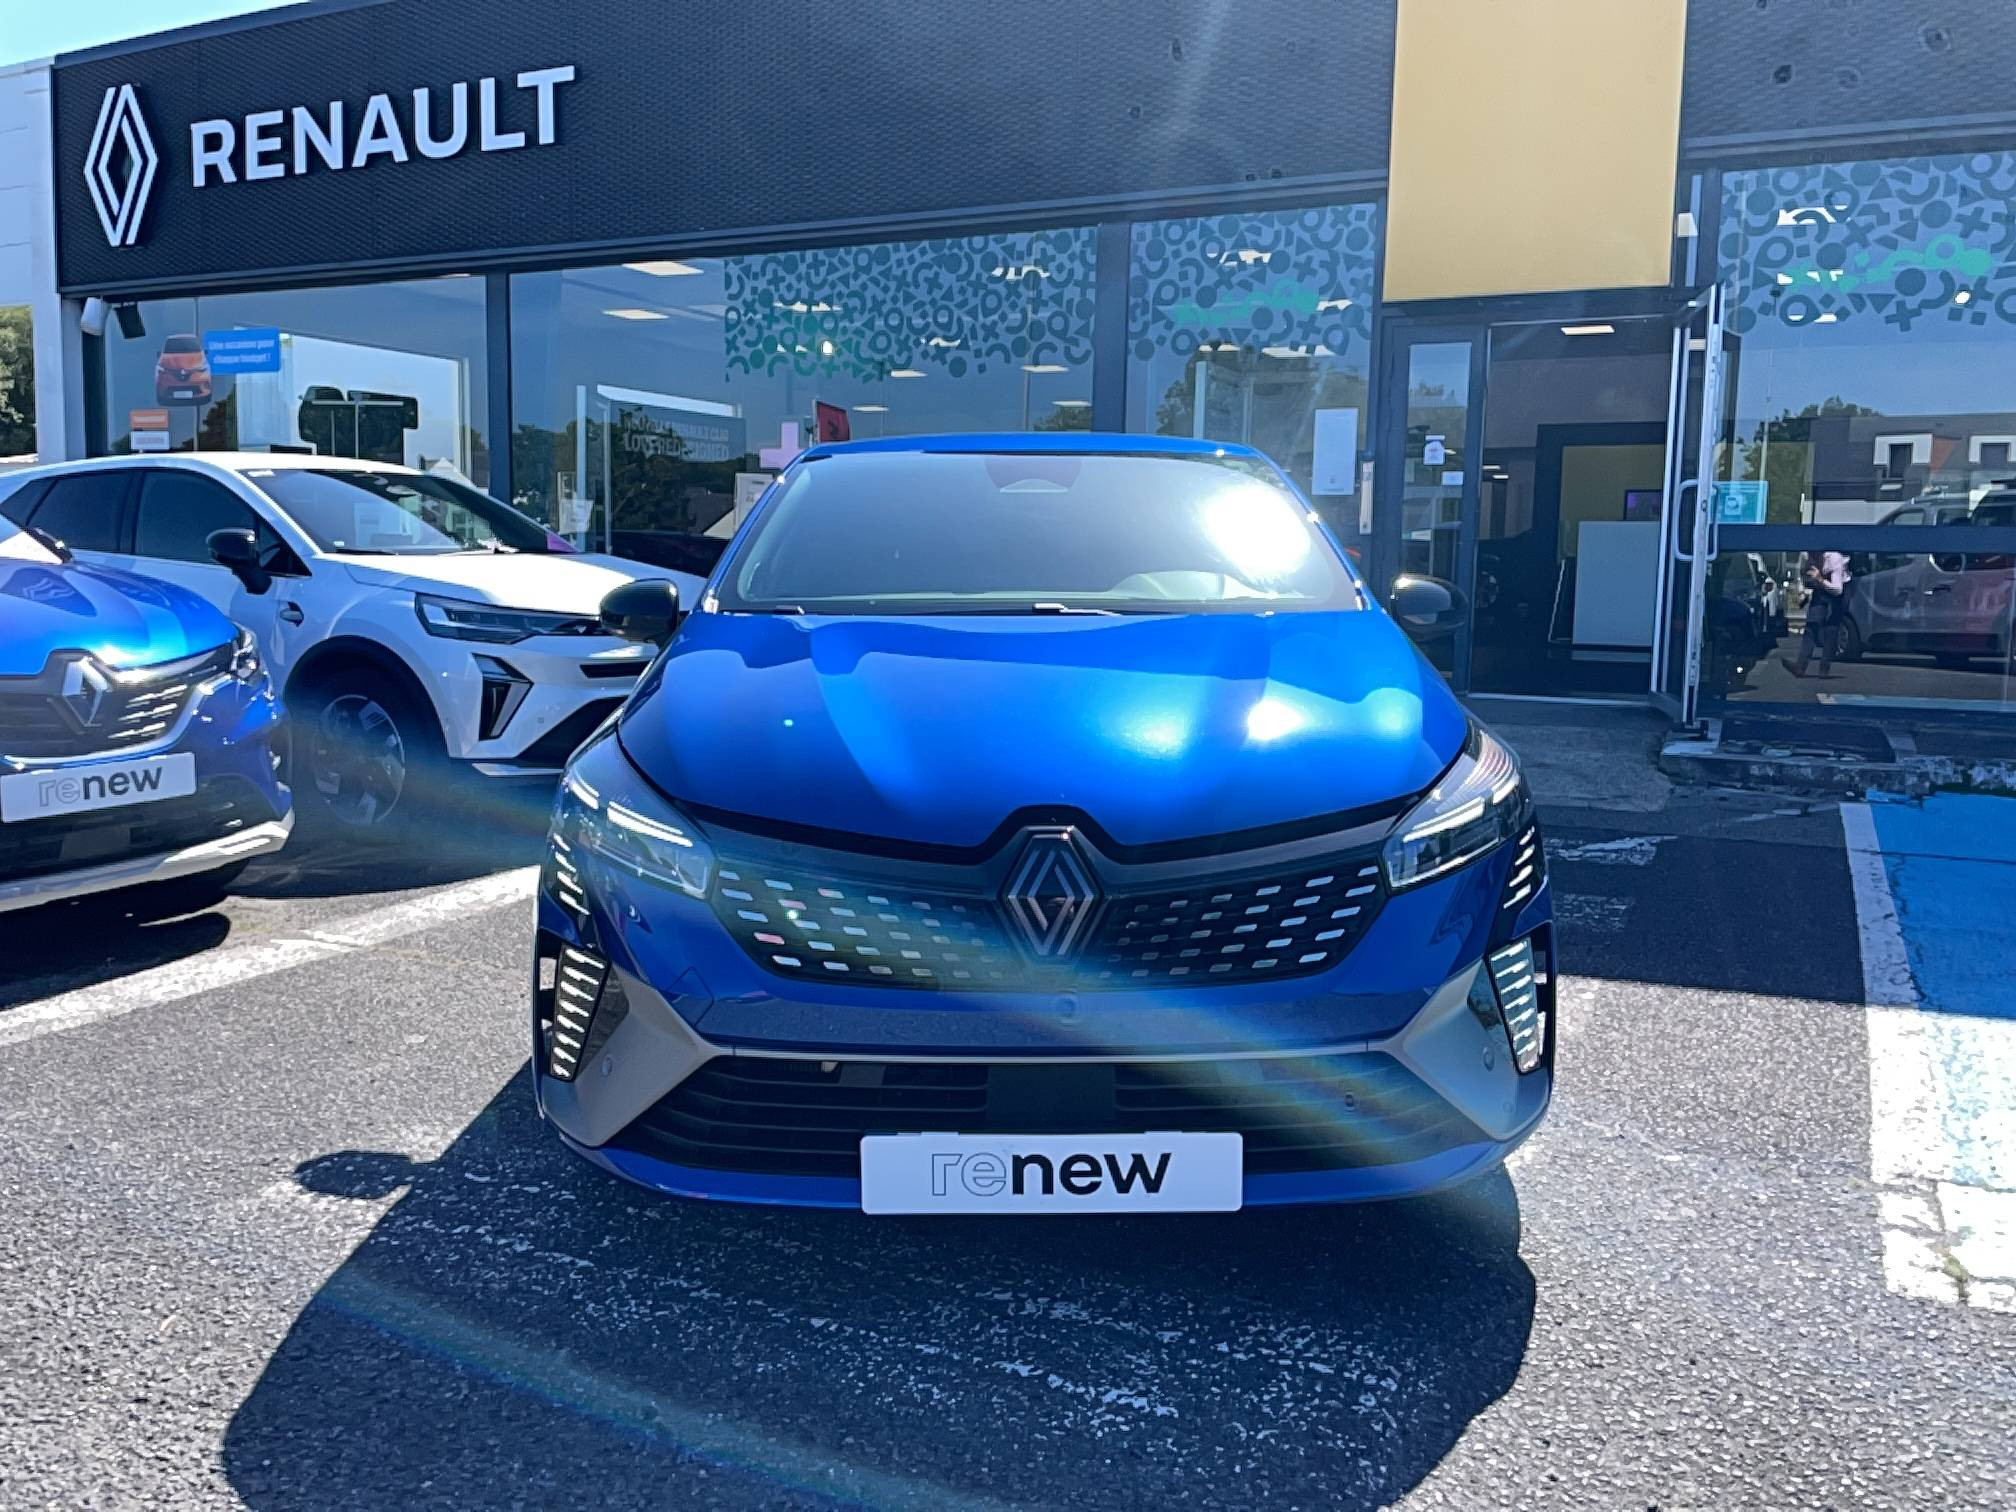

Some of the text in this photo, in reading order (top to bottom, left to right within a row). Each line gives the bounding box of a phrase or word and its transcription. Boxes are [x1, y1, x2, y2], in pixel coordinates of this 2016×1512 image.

[190, 65, 575, 188] RENAULT
[38, 766, 163, 807] renew
[931, 1152, 1173, 1197] renew
